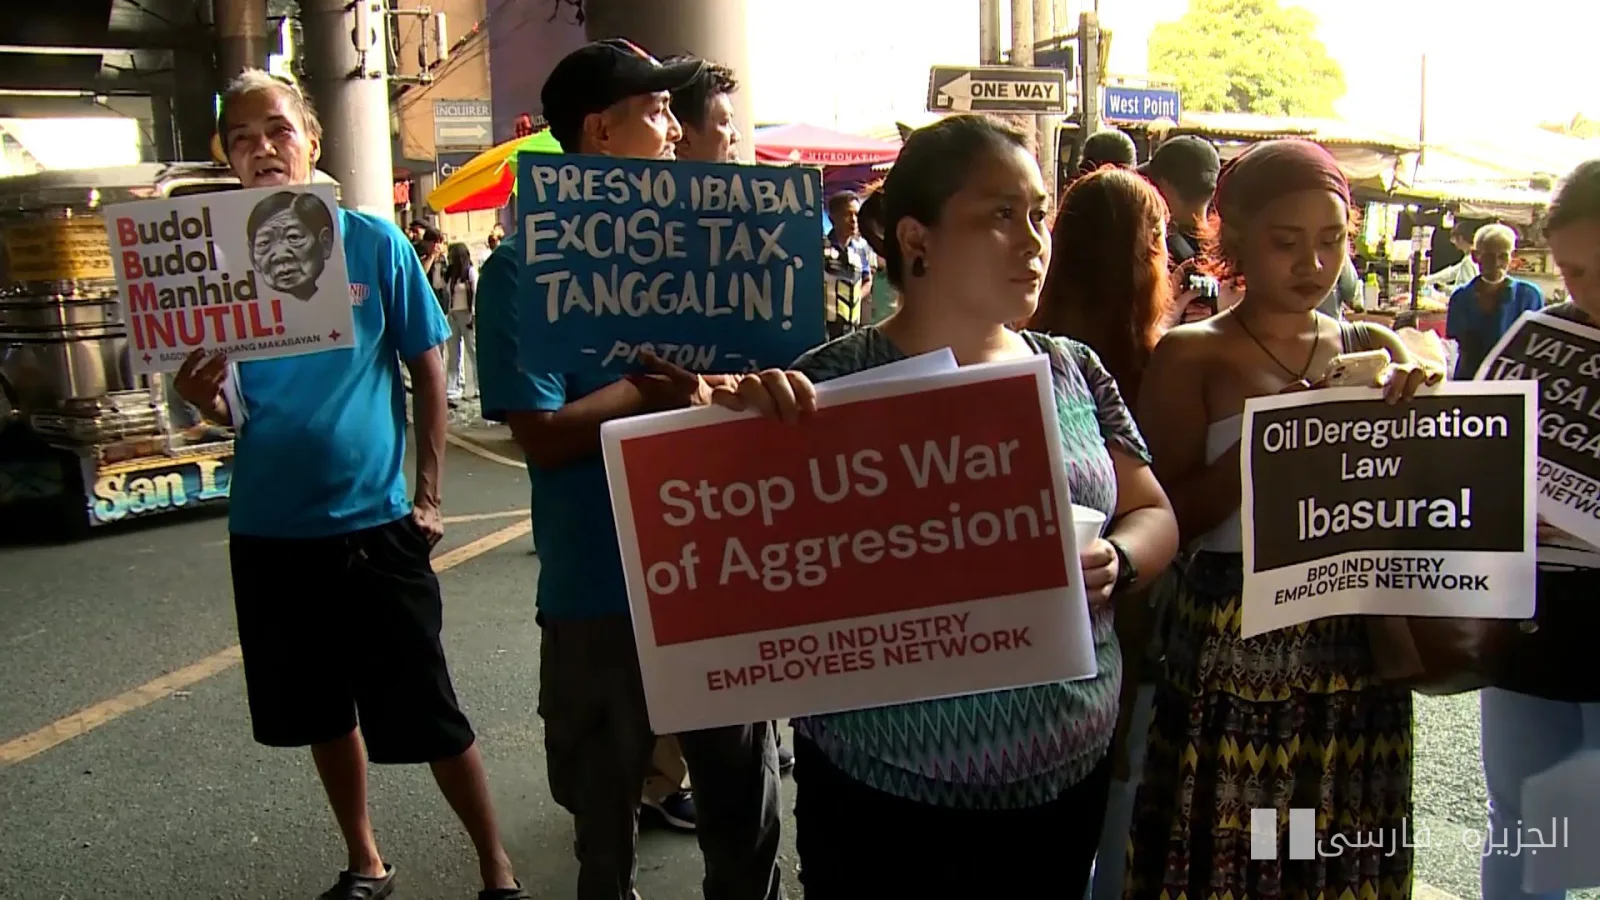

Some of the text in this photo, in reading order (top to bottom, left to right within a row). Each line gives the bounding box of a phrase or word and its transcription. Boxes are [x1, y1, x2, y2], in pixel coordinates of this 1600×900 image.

[435, 104, 490, 116] INQUIRER
[971, 82, 1054, 99] ONE WAY
[1109, 94, 1176, 117] West Point
[690, 173, 816, 218] IBABA!
[116, 206, 213, 248] Budol
[525, 208, 688, 266] EXCISE
[122, 241, 219, 281] Budol
[128, 269, 259, 313] Manhid
[535, 263, 795, 331] TANGGALIN!
[131, 299, 286, 351] INUTIL!
[258, 334, 321, 350] MAKABAYAN
[1523, 332, 1586, 368] VAT
[1543, 378, 1589, 411] SA
[1263, 408, 1509, 453] Oil Deregulation
[659, 435, 1020, 528] Stop US War
[1341, 452, 1402, 481] Law
[93, 459, 232, 522] San L
[1298, 488, 1472, 541] Ibasura!
[646, 488, 1057, 596] of Aggression!
[1274, 574, 1490, 606] EMPLOYEES NETWORK
[1306, 557, 1446, 583] BPO INDUSTRY
[706, 625, 1032, 692] EMPLOYEES NETWORK
[758, 611, 971, 662] BPO INDUSTRY
